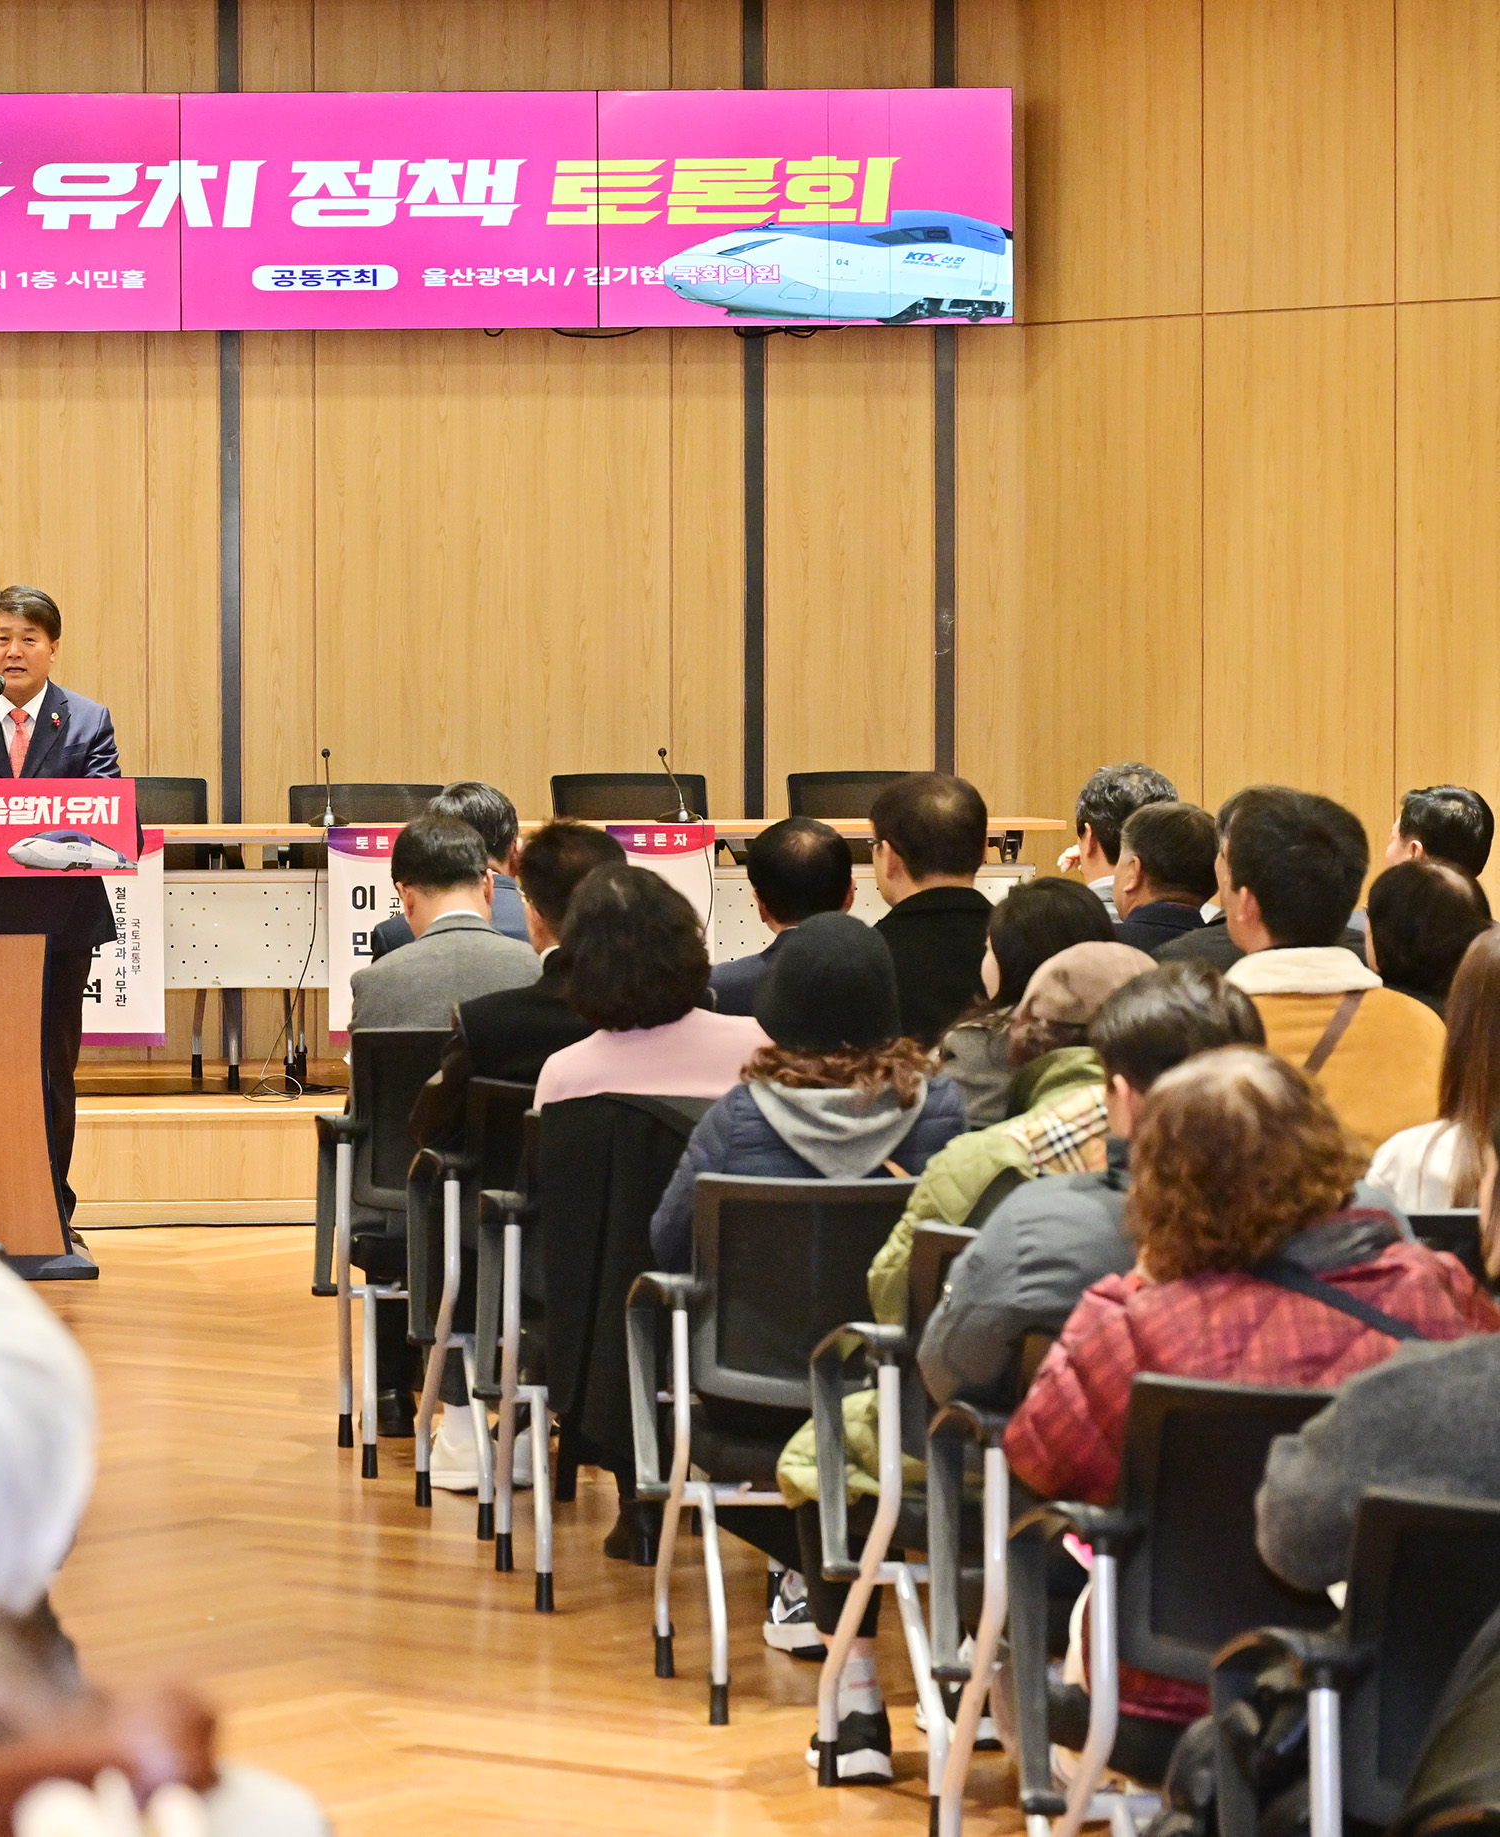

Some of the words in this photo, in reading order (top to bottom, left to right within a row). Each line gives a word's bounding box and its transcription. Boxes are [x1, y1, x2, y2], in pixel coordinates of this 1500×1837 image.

[27, 160, 267, 229] 유치
[288, 159, 527, 227] 정책
[546, 156, 901, 225] 토론회
[905, 251, 946, 262] KTX
[16, 270, 57, 289] 1층
[65, 269, 147, 289] 시민홀
[271, 268, 378, 287] 공동주최
[421, 267, 555, 286] 울산광역시
[583, 265, 665, 286] 김기현
[671, 264, 781, 285] 국회의원
[65, 796, 121, 824] 유치
[356, 836, 389, 849] 토론
[115, 887, 127, 960] 철도운영과
[131, 918, 141, 975] 국토교통부
[115, 966, 127, 1007] 사무관
